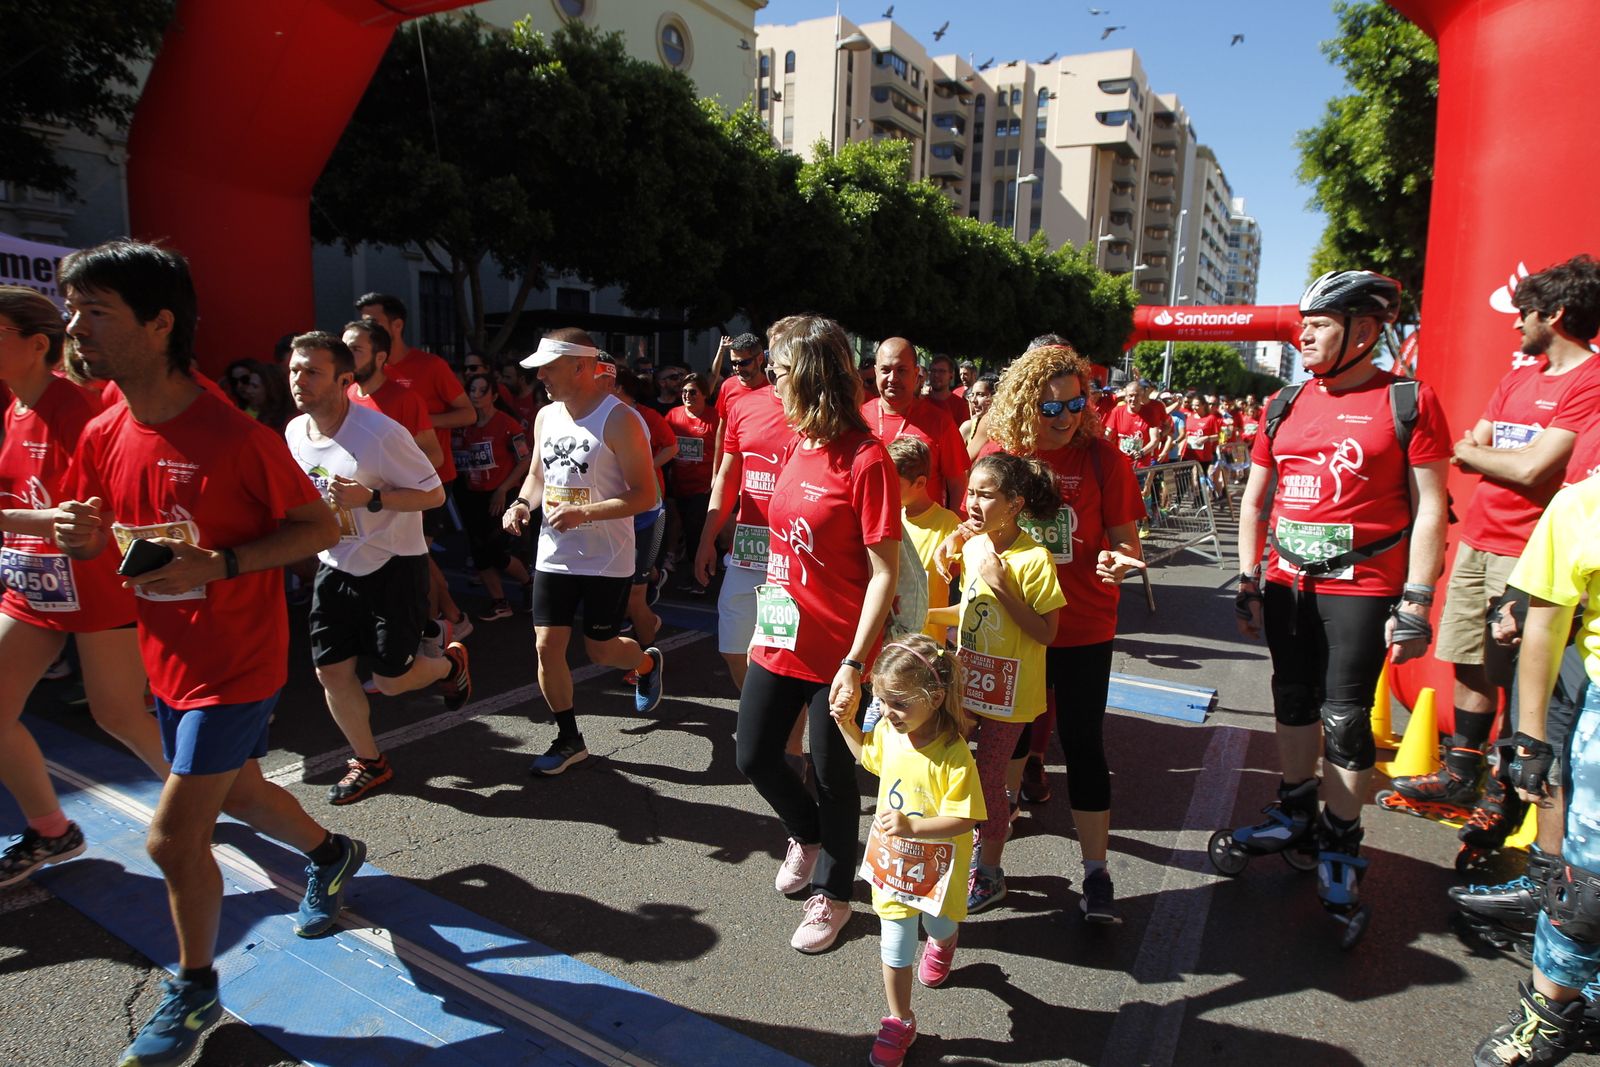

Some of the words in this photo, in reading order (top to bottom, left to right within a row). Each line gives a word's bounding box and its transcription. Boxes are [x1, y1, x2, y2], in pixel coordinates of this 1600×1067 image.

[0, 252, 61, 282] me
[1174, 312, 1253, 325] Santander
[1028, 525, 1059, 544] 86
[1284, 537, 1338, 559] 1249
[3, 569, 59, 592] 2050
[762, 604, 793, 626] 1280
[966, 688, 985, 700] ISABEL
[877, 846, 926, 883] 314
[885, 874, 914, 892] NATALIA
